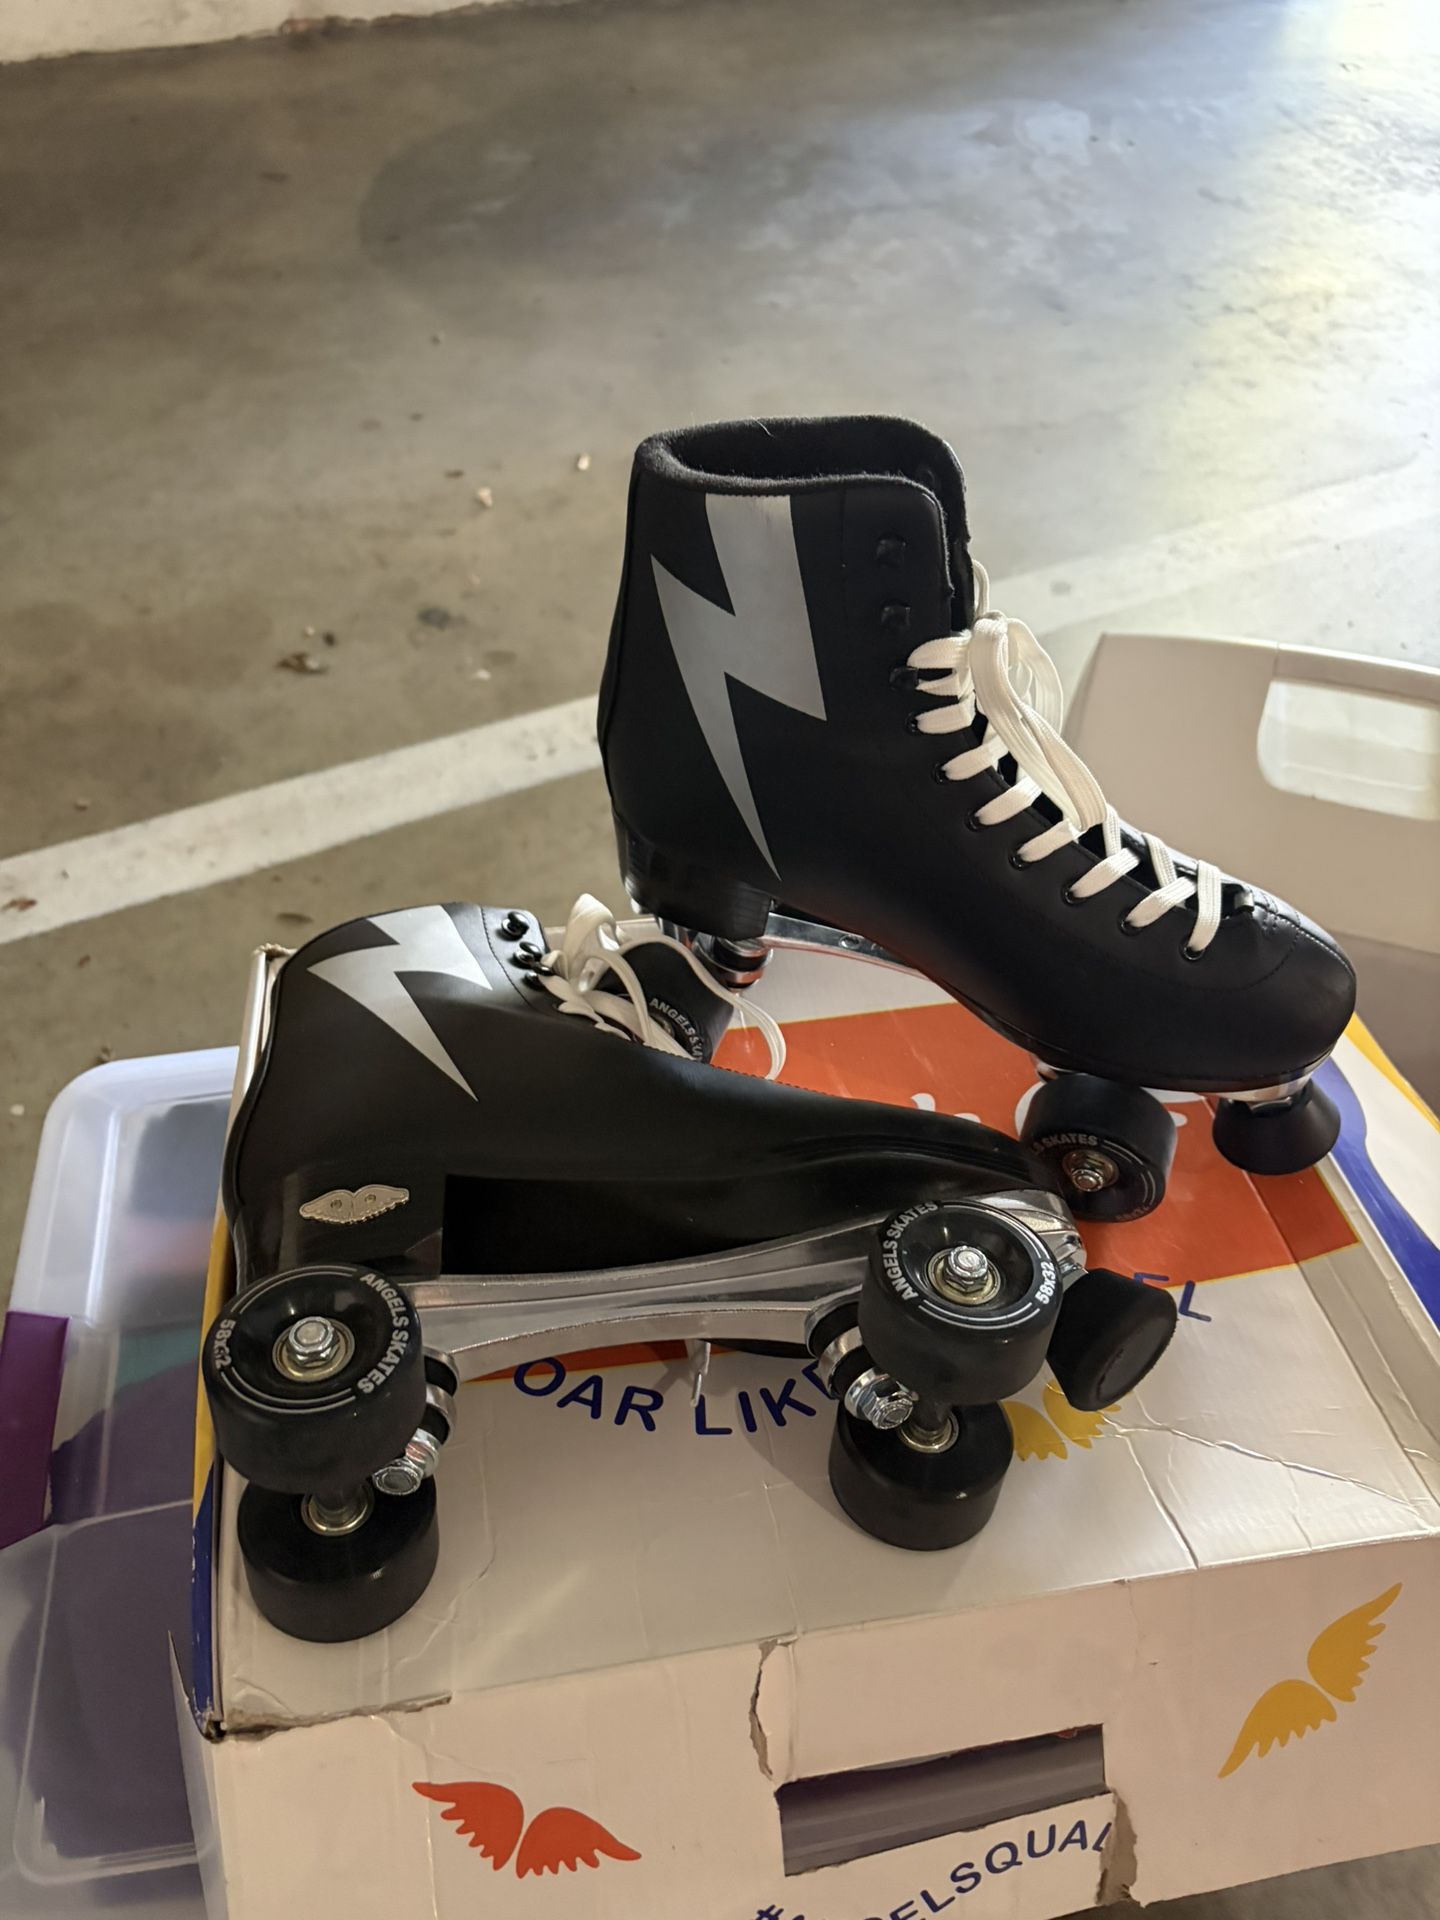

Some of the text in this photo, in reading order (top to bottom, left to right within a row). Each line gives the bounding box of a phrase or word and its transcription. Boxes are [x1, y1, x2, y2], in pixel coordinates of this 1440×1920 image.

[649, 998, 696, 1036] ANGELS
[1042, 1132, 1098, 1148] SKATES
[883, 1202, 938, 1300] ANGELS SKATES
[357, 1273, 409, 1394] ANGELS SKATES
[513, 1357, 663, 1432] OAR
